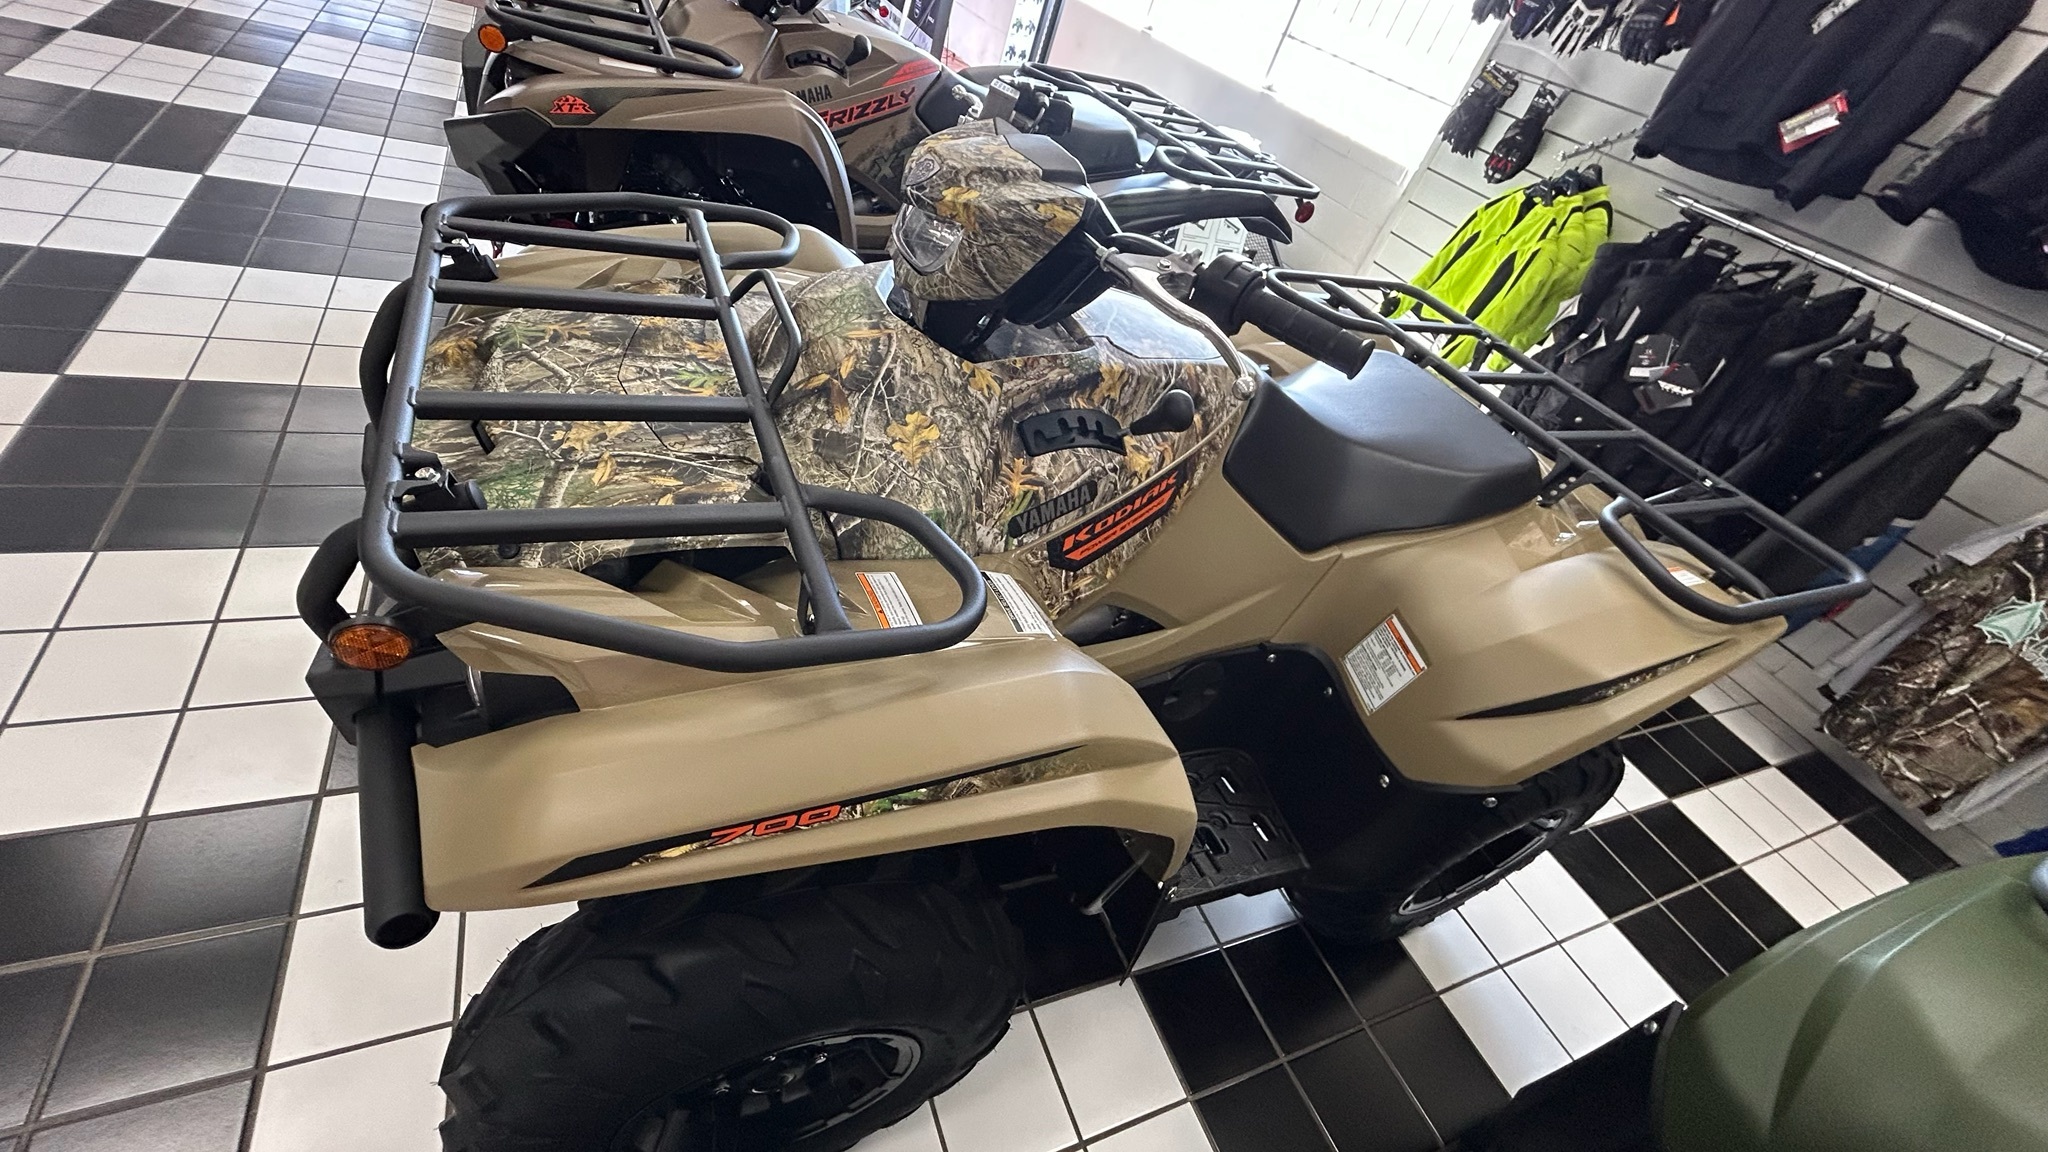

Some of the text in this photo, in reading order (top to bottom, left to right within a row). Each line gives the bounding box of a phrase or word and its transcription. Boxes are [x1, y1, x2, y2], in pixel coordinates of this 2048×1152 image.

[553, 103, 591, 113] XT-R
[792, 84, 833, 104] MAHA
[1016, 483, 1091, 533] YAMAHA
[1062, 470, 1179, 551] KODIAK
[709, 804, 842, 846] 700
